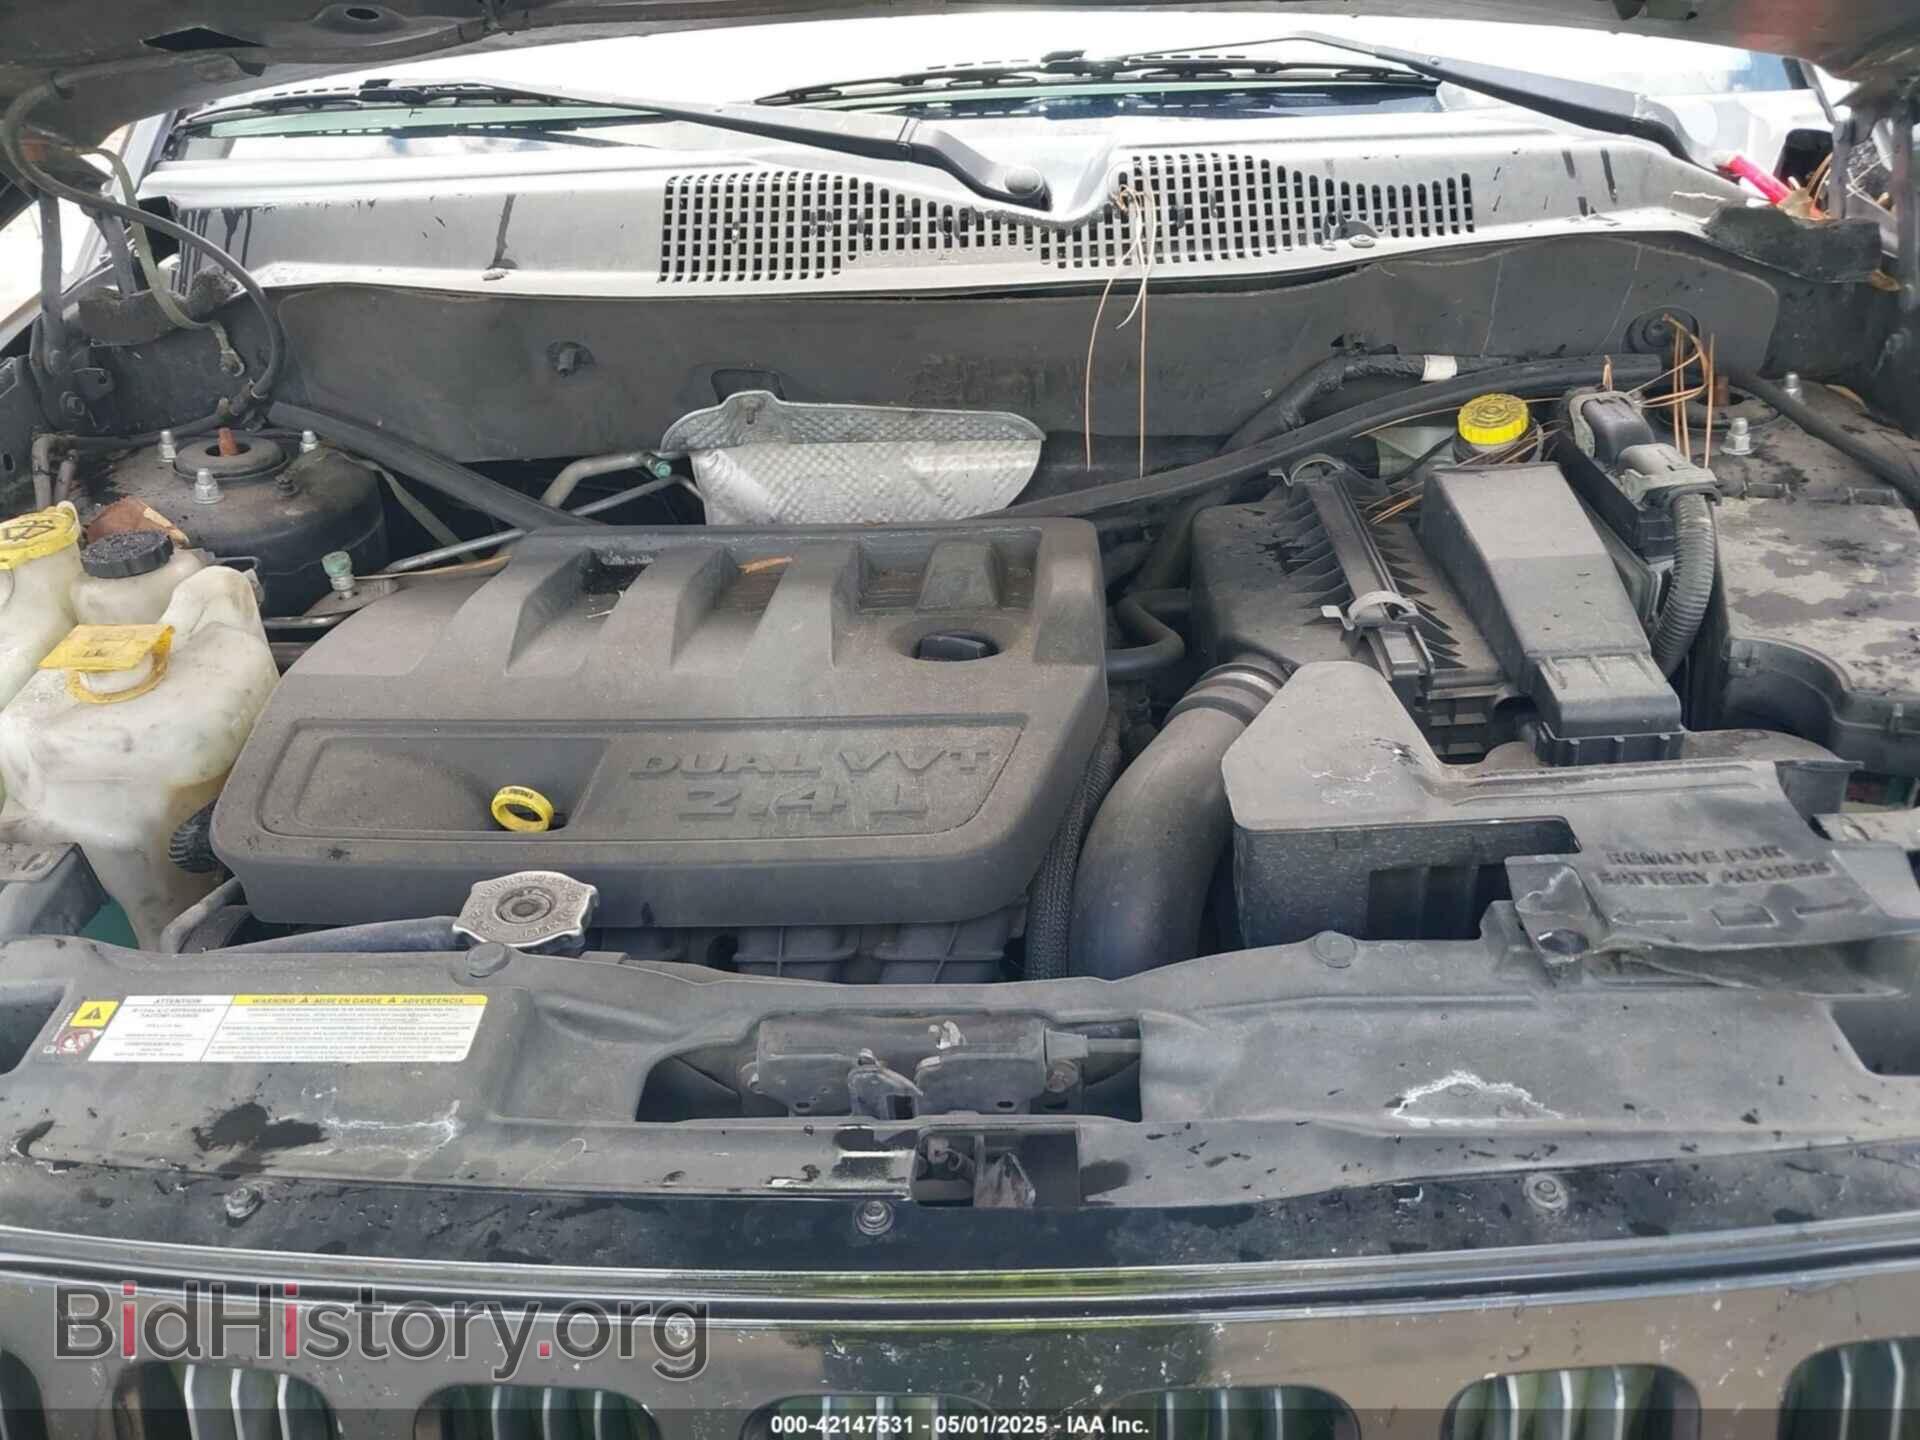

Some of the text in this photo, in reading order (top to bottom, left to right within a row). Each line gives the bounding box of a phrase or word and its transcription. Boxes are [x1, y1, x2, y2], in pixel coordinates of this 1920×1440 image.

[630, 749, 991, 779] DUAL VVT
[1606, 845, 1786, 866] REMOVE FOR
[1597, 861, 1835, 887] BATTERY ACCESS
